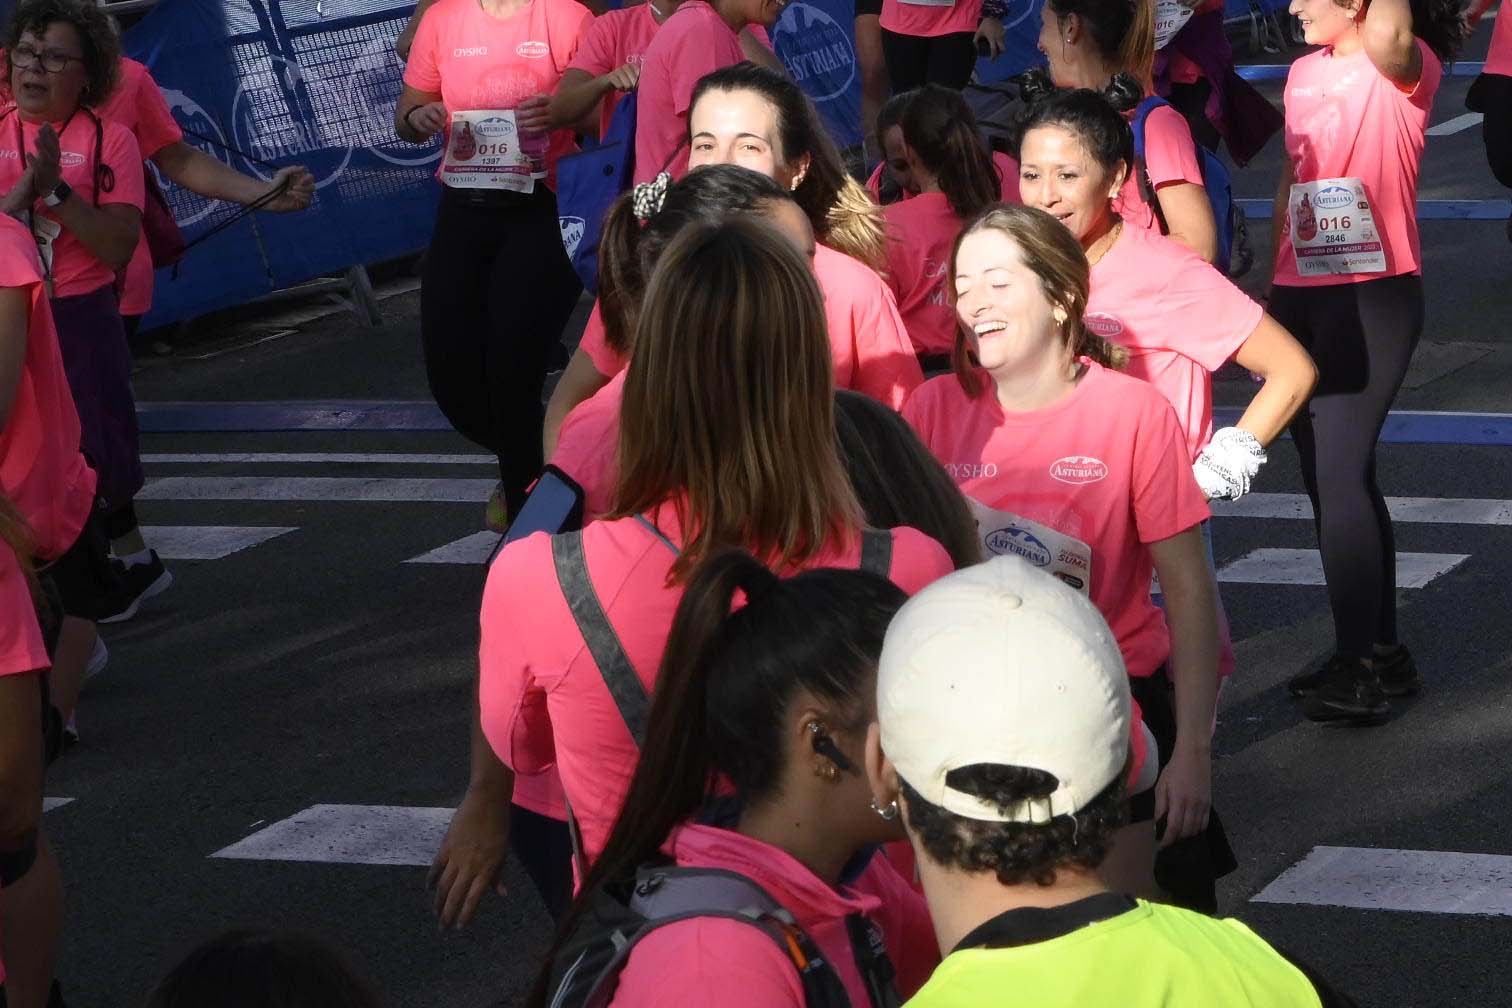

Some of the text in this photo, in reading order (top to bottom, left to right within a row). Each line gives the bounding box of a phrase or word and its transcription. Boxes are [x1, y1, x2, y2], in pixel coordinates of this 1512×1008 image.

[478, 143, 508, 155] 016
[481, 157, 501, 165] 1397
[1319, 215, 1351, 231] 016
[1325, 234, 1346, 243] 2846
[1053, 466, 1105, 478] ASTURIANA
[990, 533, 1046, 566] ASTURIANA
[1058, 553, 1087, 570] SUMA
